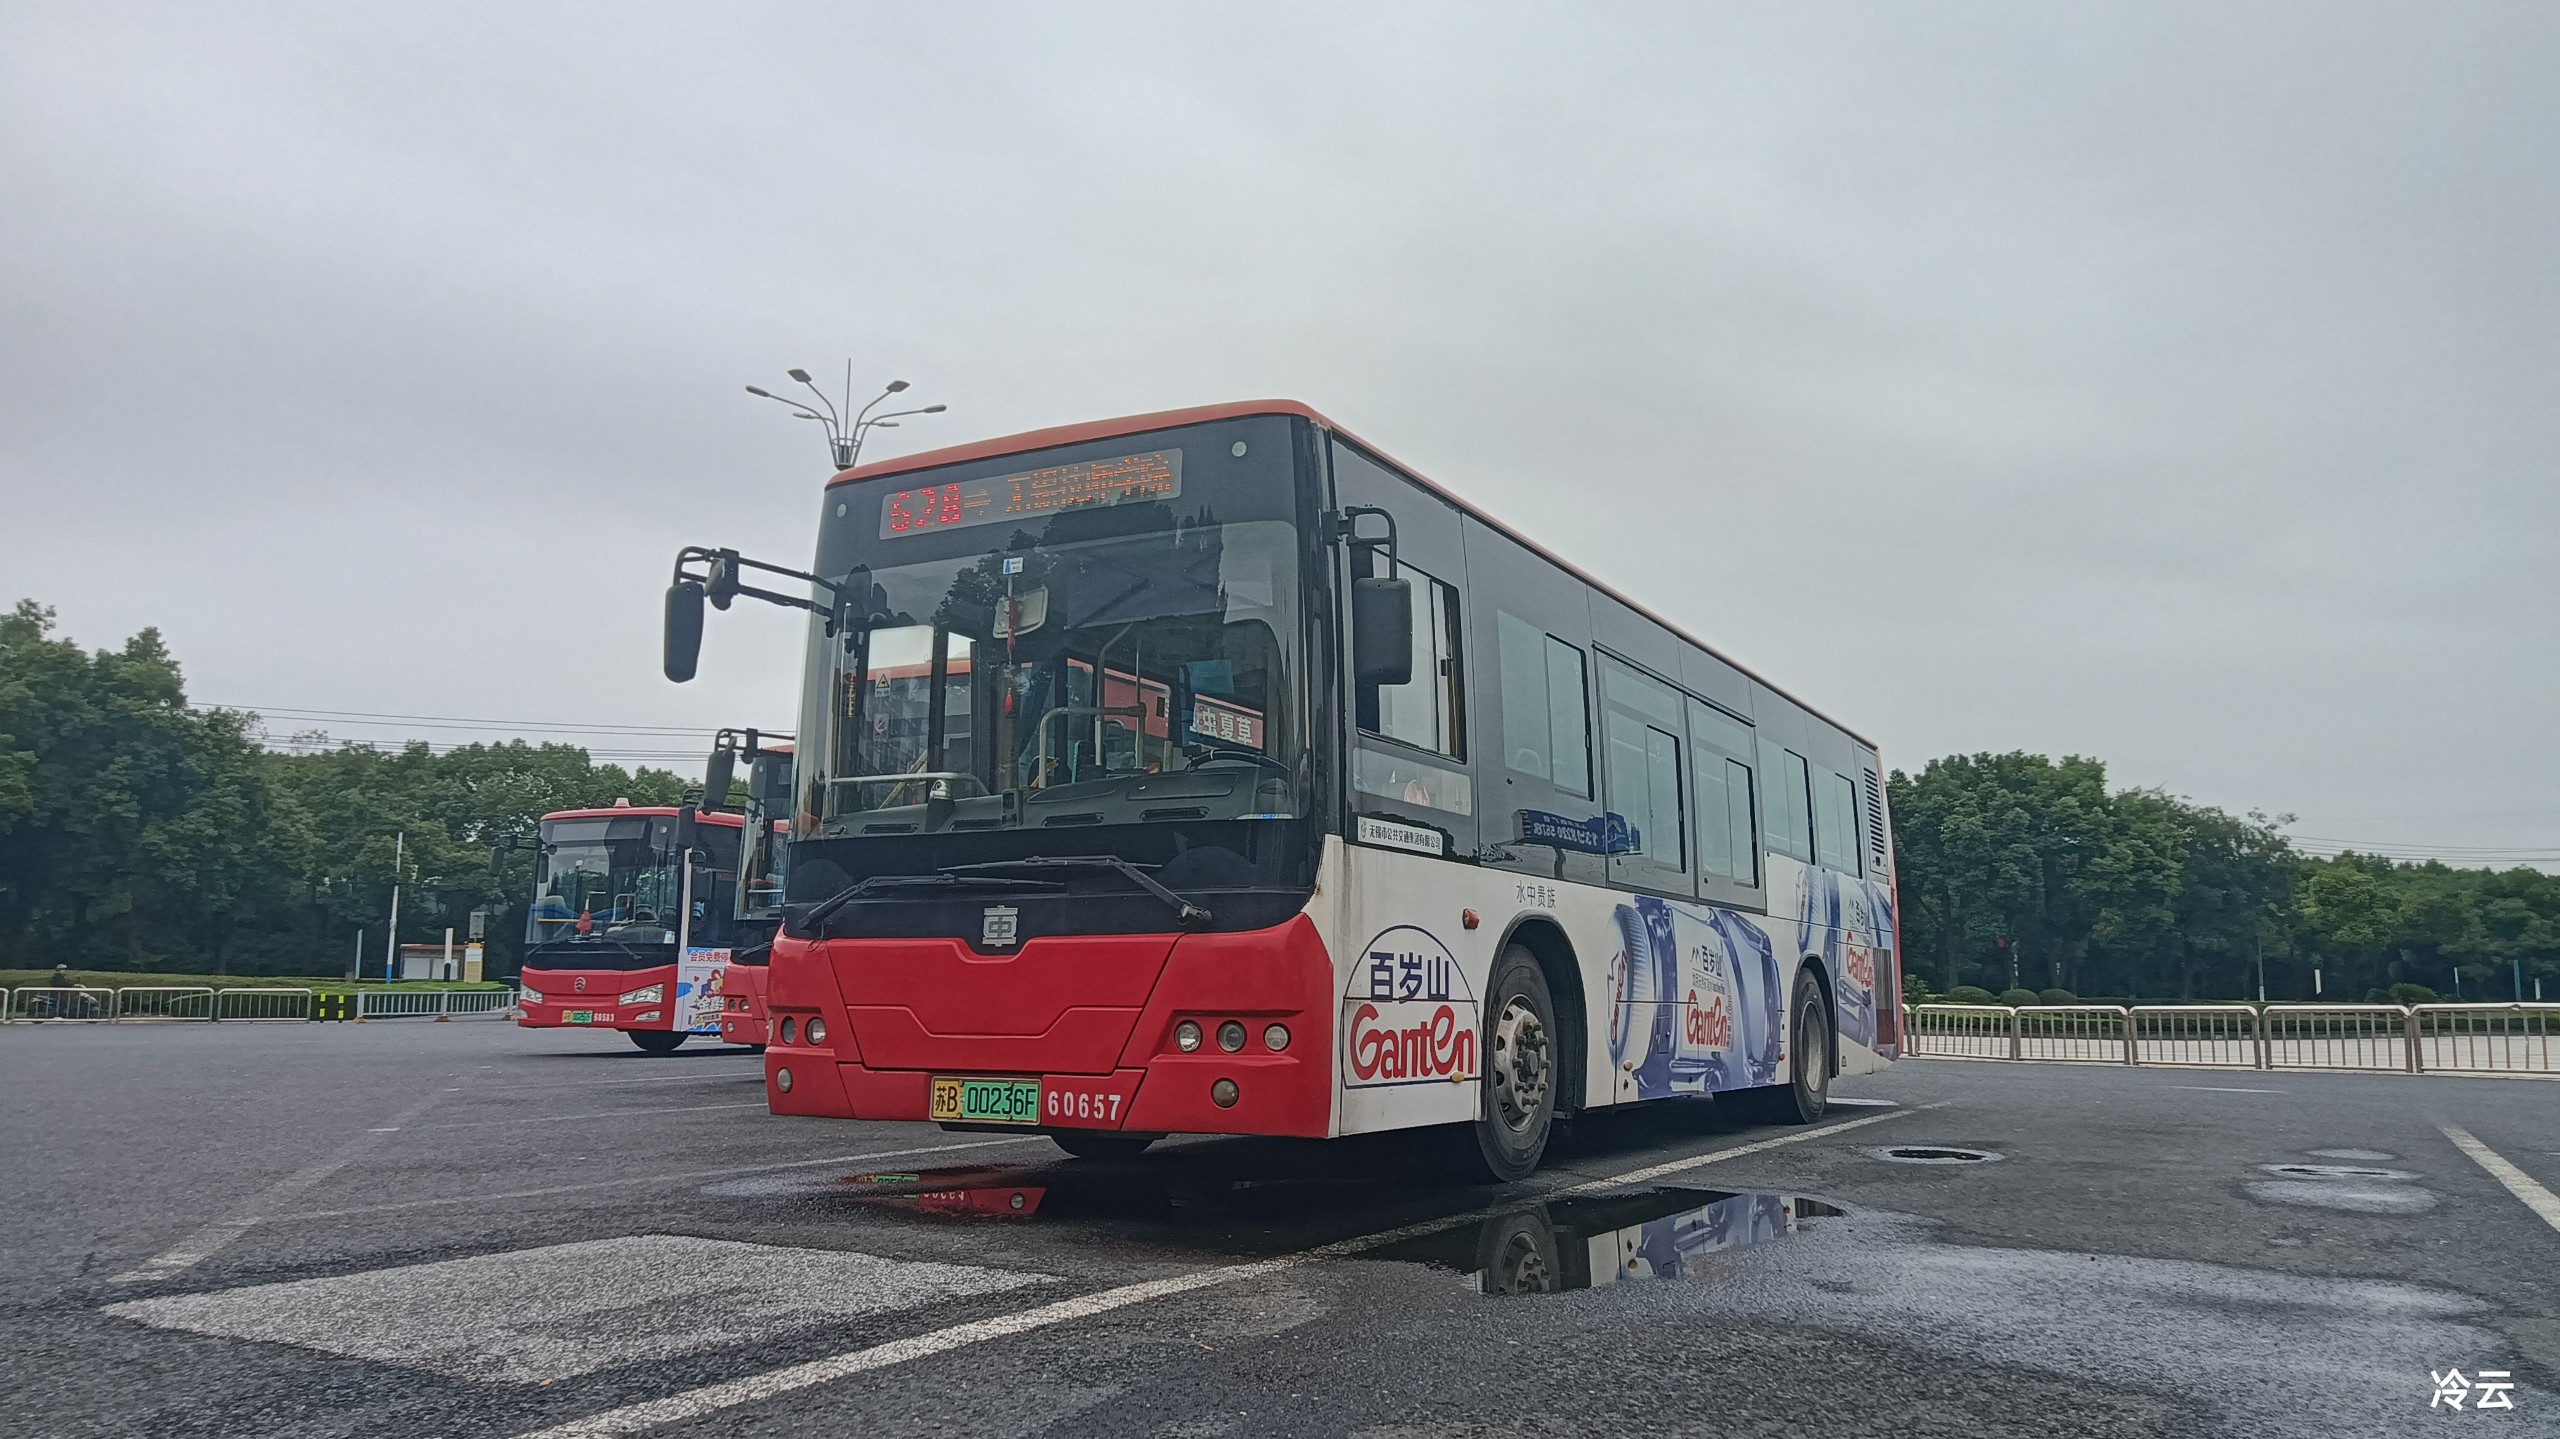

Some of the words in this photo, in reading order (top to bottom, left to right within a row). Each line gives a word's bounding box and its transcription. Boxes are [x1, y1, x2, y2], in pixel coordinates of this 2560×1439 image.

[1516, 880, 1556, 909] 水中贵族
[1369, 951, 1451, 1004] 百岁山
[1349, 1003, 1475, 1081] Ganten
[1686, 988, 1728, 1048] Ganten
[1047, 1090, 1122, 1122] 60657
